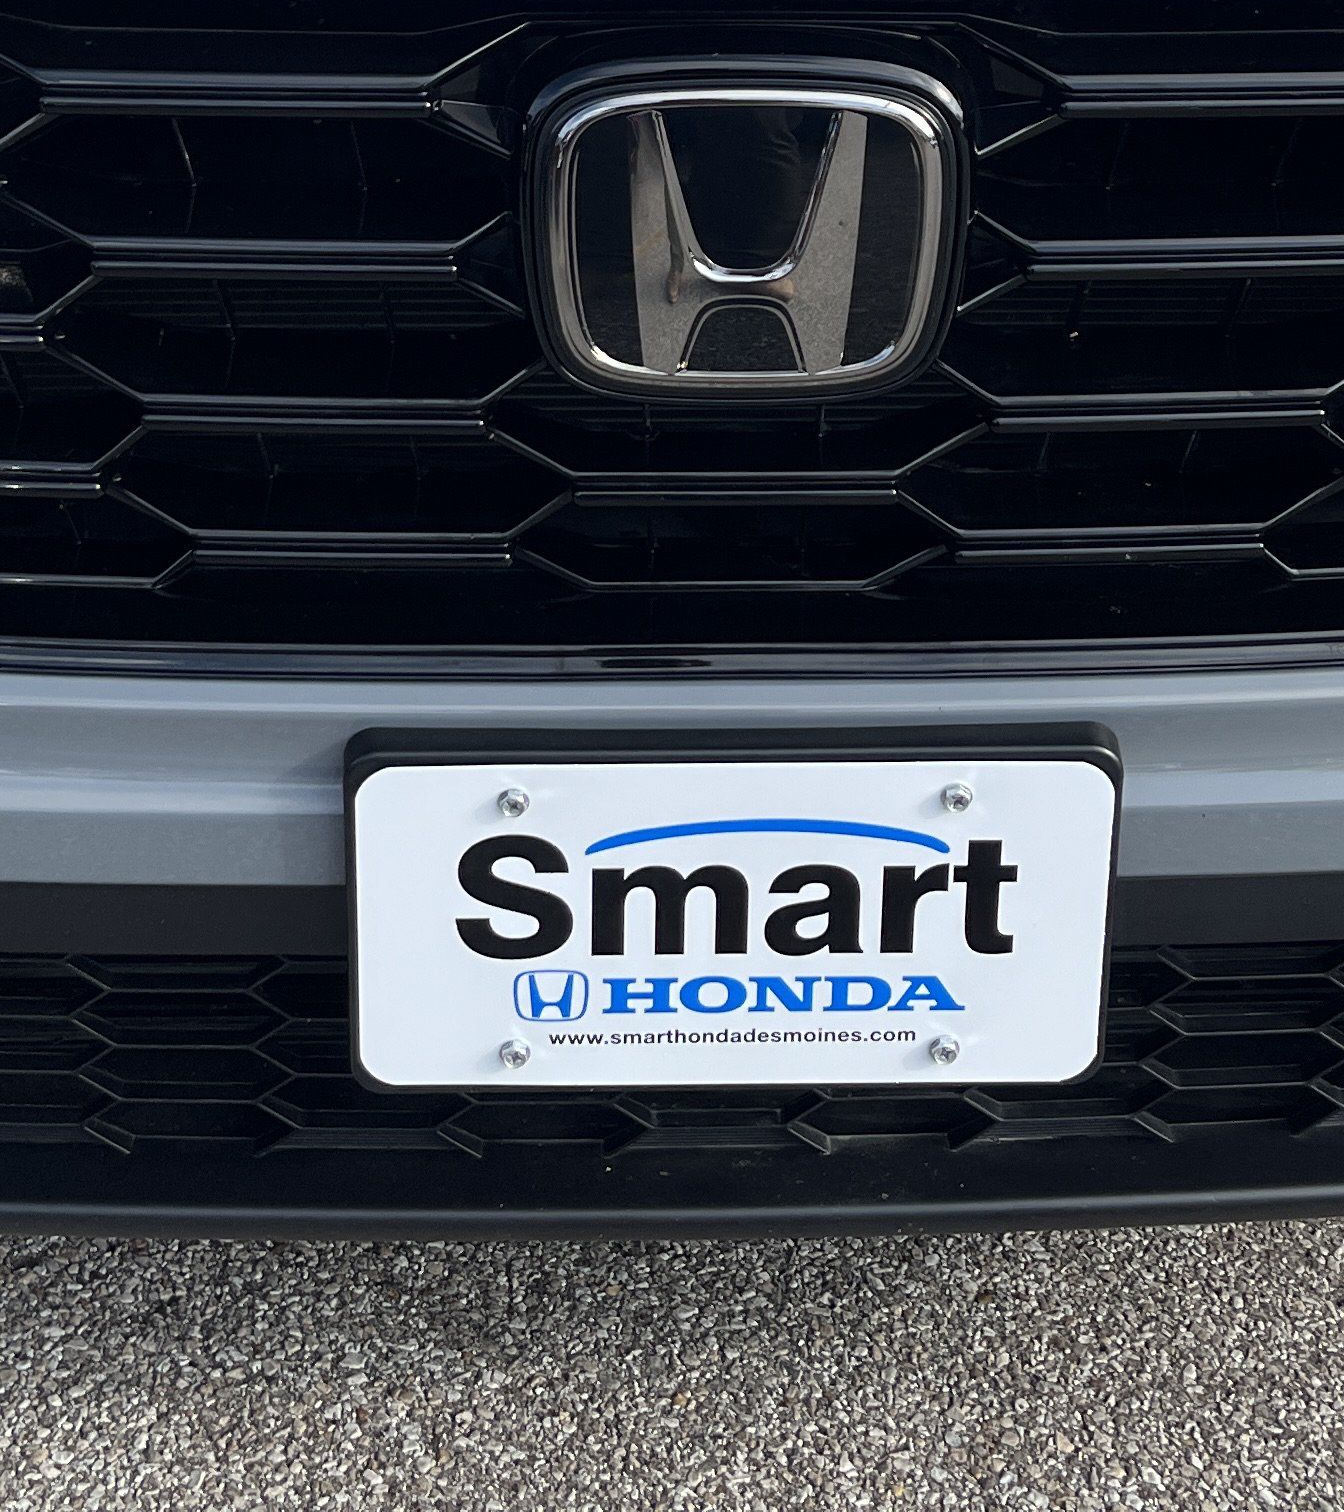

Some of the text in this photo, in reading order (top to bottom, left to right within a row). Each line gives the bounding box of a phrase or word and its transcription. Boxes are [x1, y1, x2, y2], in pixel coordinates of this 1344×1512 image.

[455, 834, 1018, 960] Smart
[602, 975, 965, 1014] HONDA
[548, 1028, 917, 1046] www.smarthondadesmoines.com
